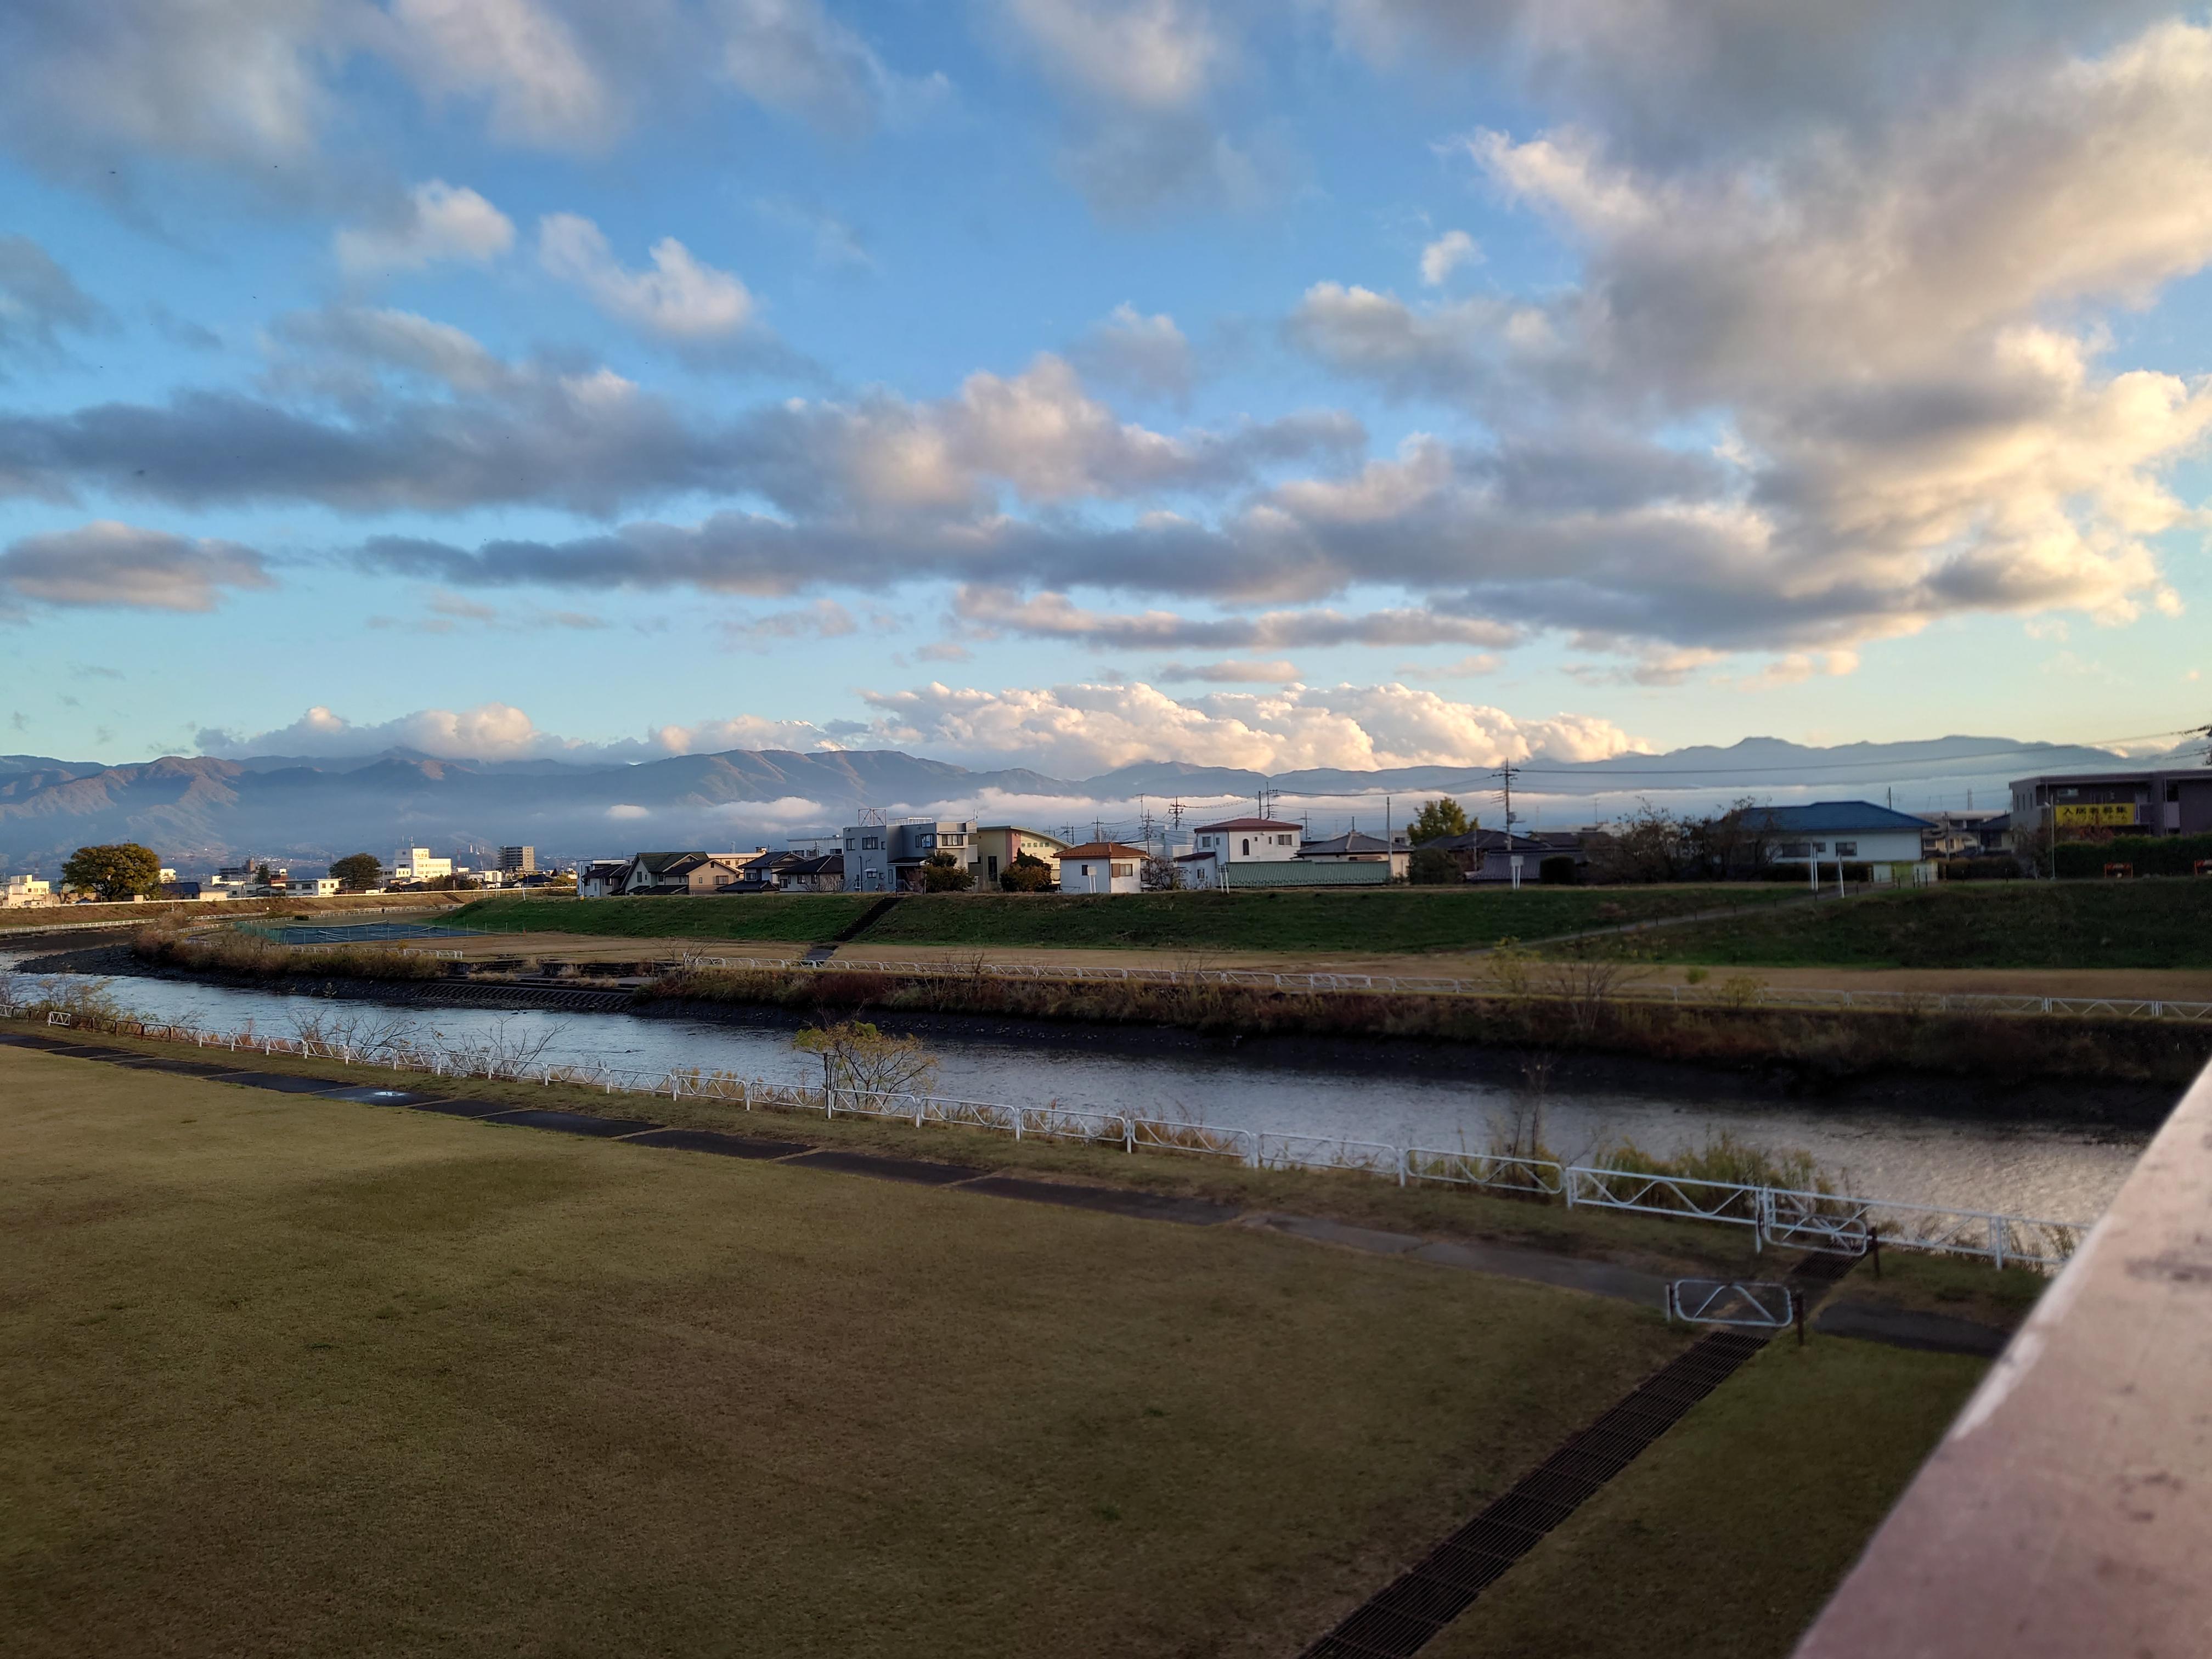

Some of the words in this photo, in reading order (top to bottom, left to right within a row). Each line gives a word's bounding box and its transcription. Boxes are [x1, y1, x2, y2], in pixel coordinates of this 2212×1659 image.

[2063, 806, 2127, 815] 入居者募集
